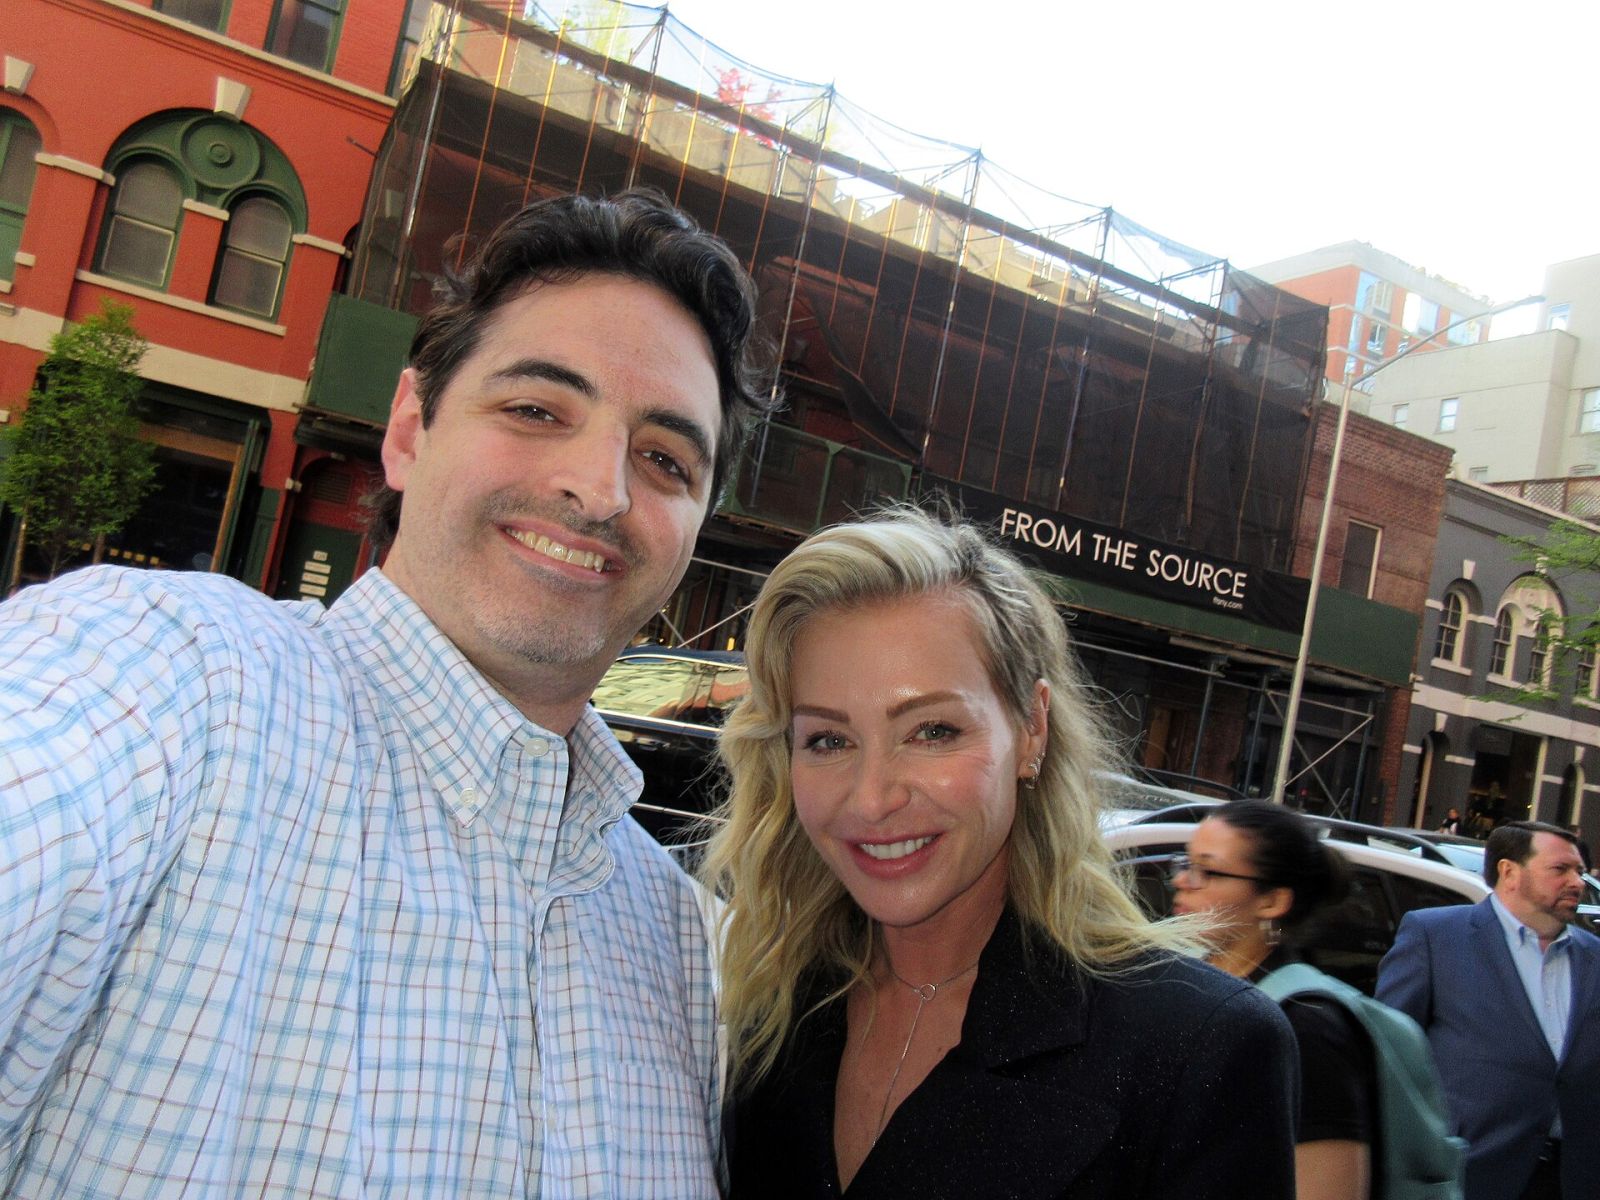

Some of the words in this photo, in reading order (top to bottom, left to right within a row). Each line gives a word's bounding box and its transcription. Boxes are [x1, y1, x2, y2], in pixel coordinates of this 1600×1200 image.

[1001, 508, 1082, 556] FROM
[1092, 533, 1138, 571] THE
[1145, 549, 1248, 599] SOURCE
